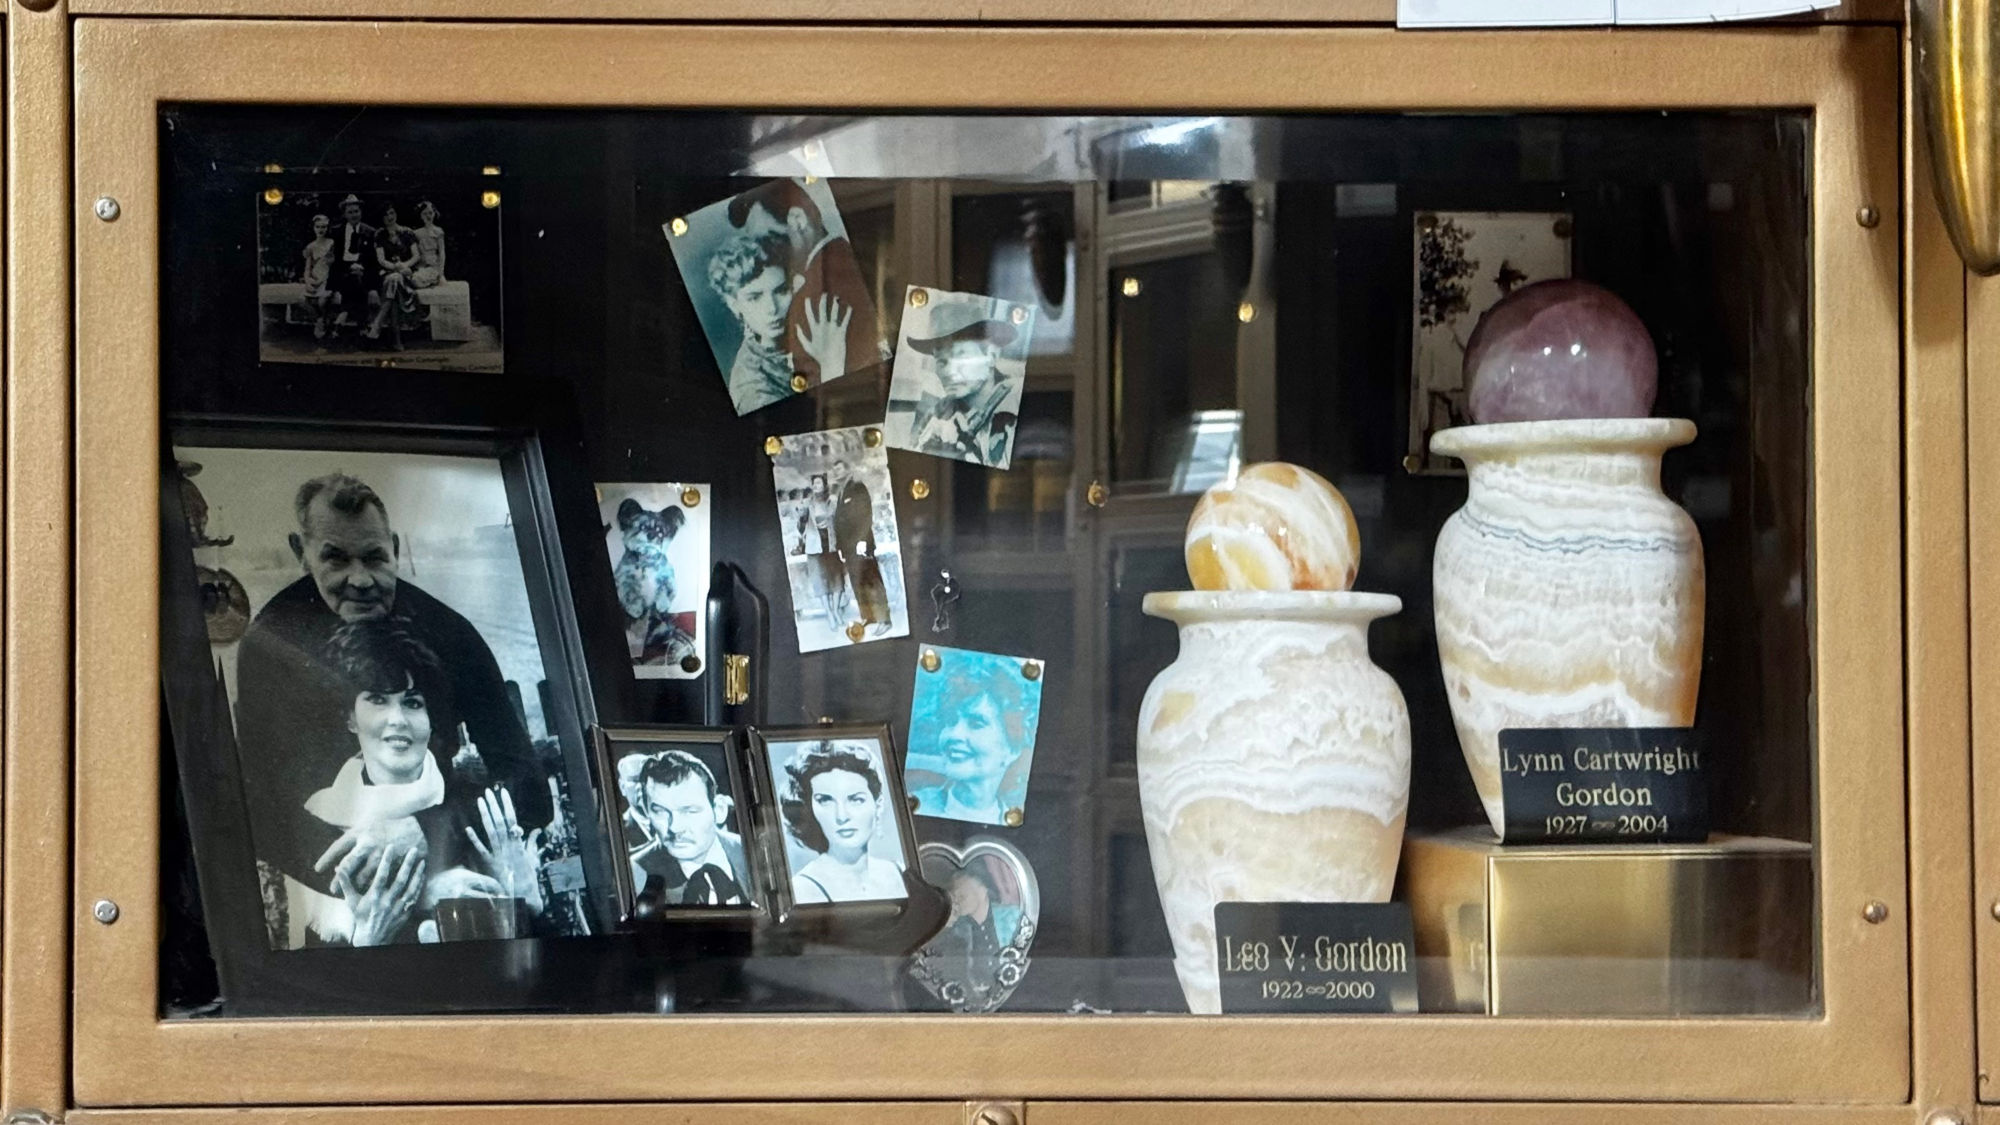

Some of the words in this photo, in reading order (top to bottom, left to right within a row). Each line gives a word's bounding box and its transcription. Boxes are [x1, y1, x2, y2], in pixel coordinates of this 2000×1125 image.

[1503, 748, 1564, 777] Lynn
[1573, 747, 1699, 775] Cartwright
[1556, 782, 1652, 807] Gordon
[1545, 815, 1587, 835] 1927
[1618, 815, 1669, 835] 2004
[1224, 935, 1270, 972] Leo
[1314, 935, 1408, 973] Gordon
[1262, 980, 1304, 999] 1922
[1325, 980, 1375, 999] 2000
